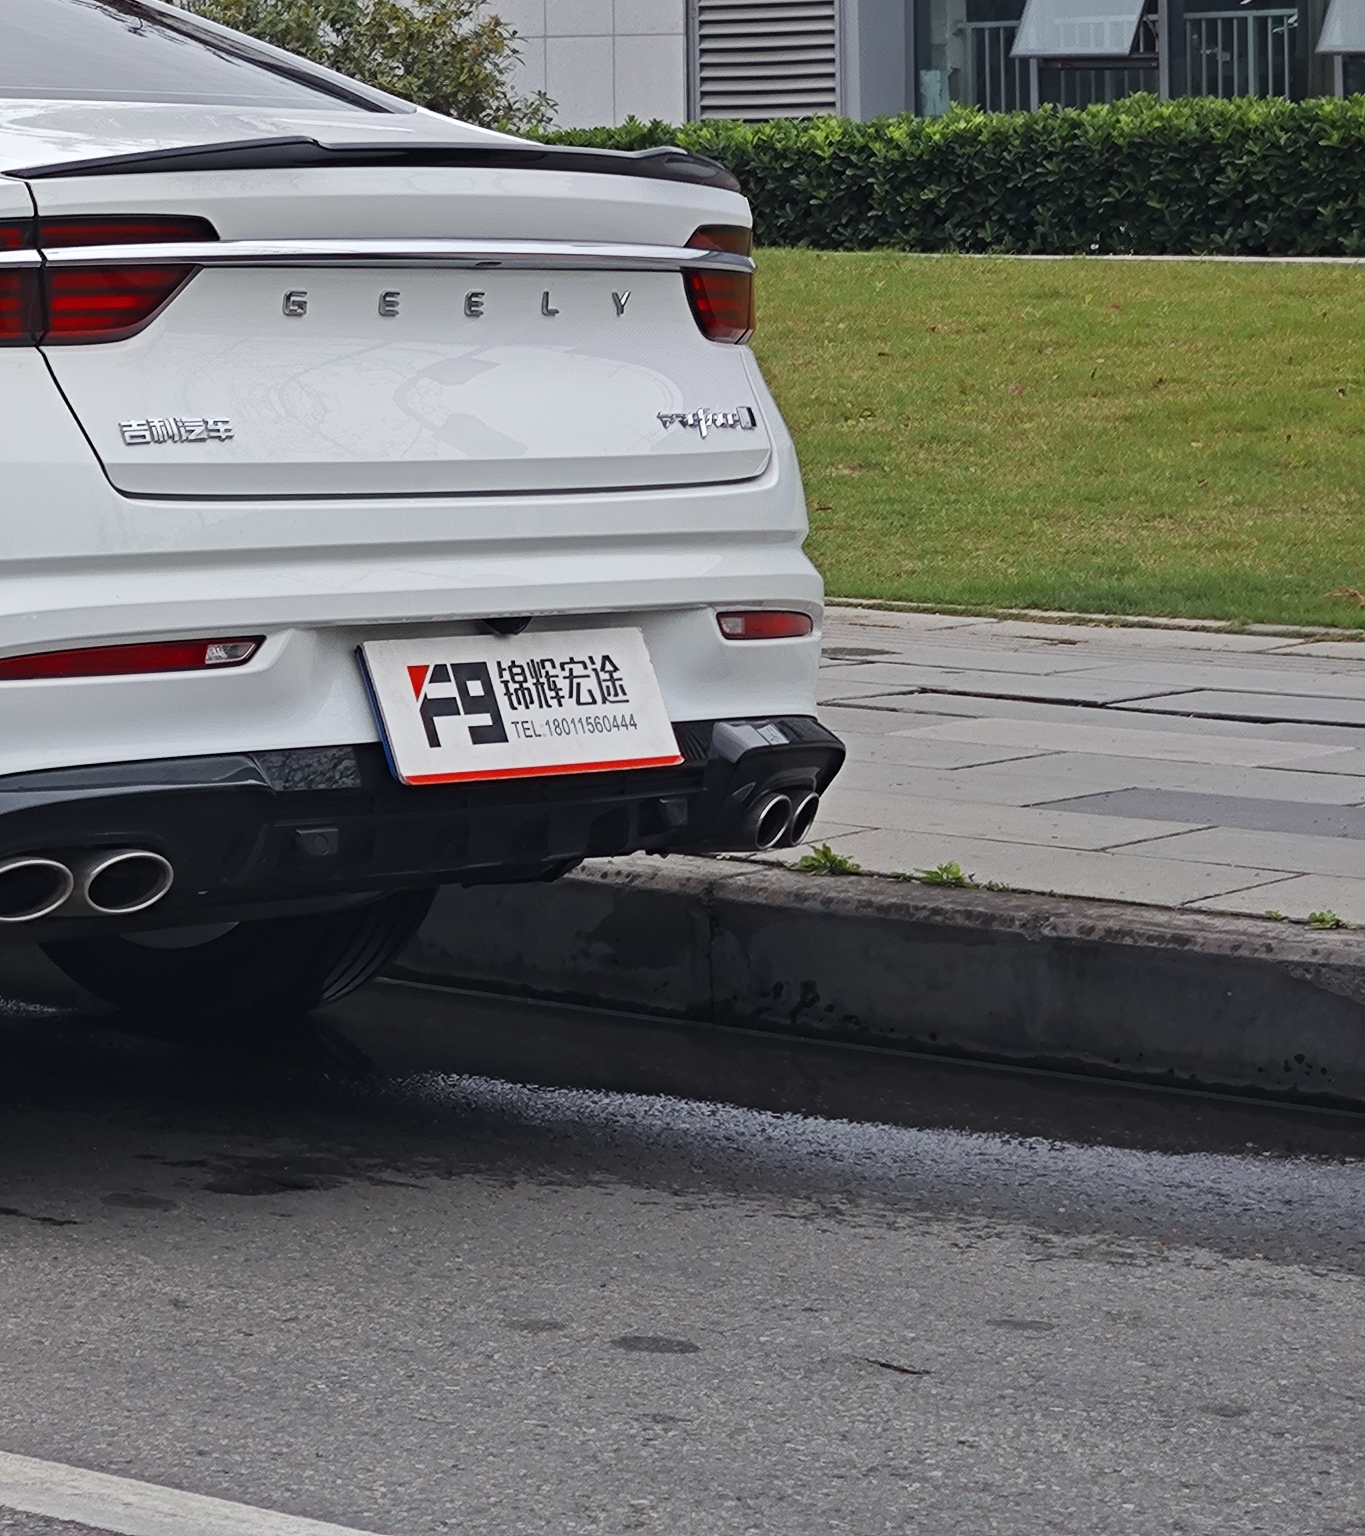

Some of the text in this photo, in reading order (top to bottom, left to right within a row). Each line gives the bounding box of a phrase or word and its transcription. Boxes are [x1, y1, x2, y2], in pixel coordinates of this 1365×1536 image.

[283, 290, 632, 317] GEELY
[119, 417, 235, 446] 吉利汽车
[496, 654, 630, 711] 锦辉宏途
